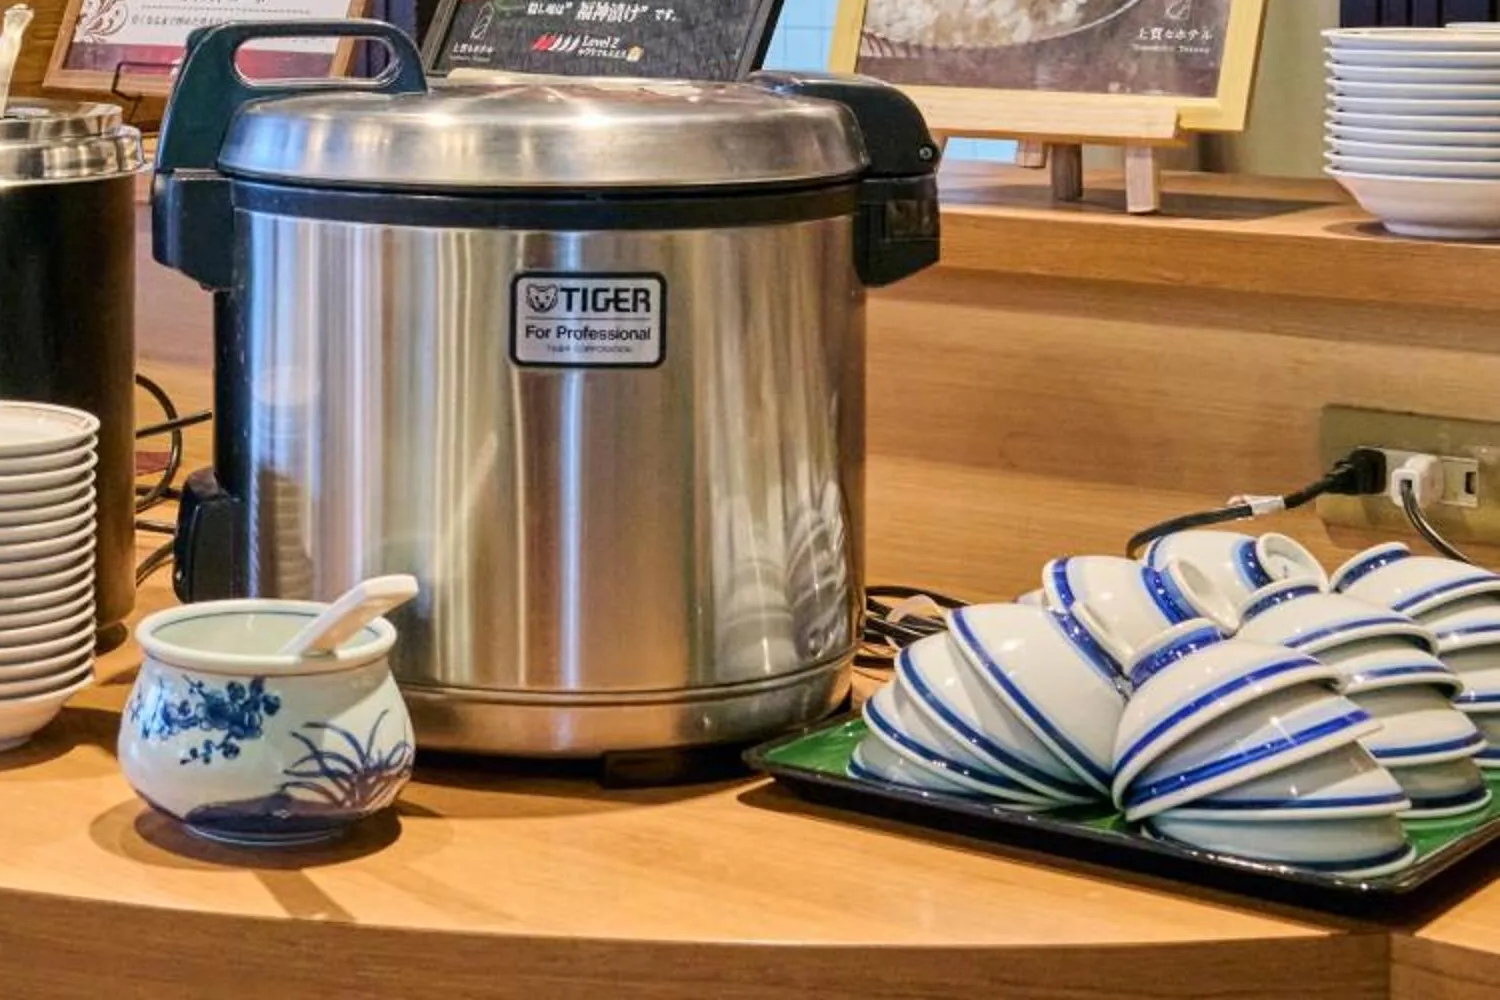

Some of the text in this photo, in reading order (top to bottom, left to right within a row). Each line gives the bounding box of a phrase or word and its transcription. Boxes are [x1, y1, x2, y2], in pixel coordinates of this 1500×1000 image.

[560, 287, 651, 313] TIGER
[525, 325, 651, 341] For Professional
